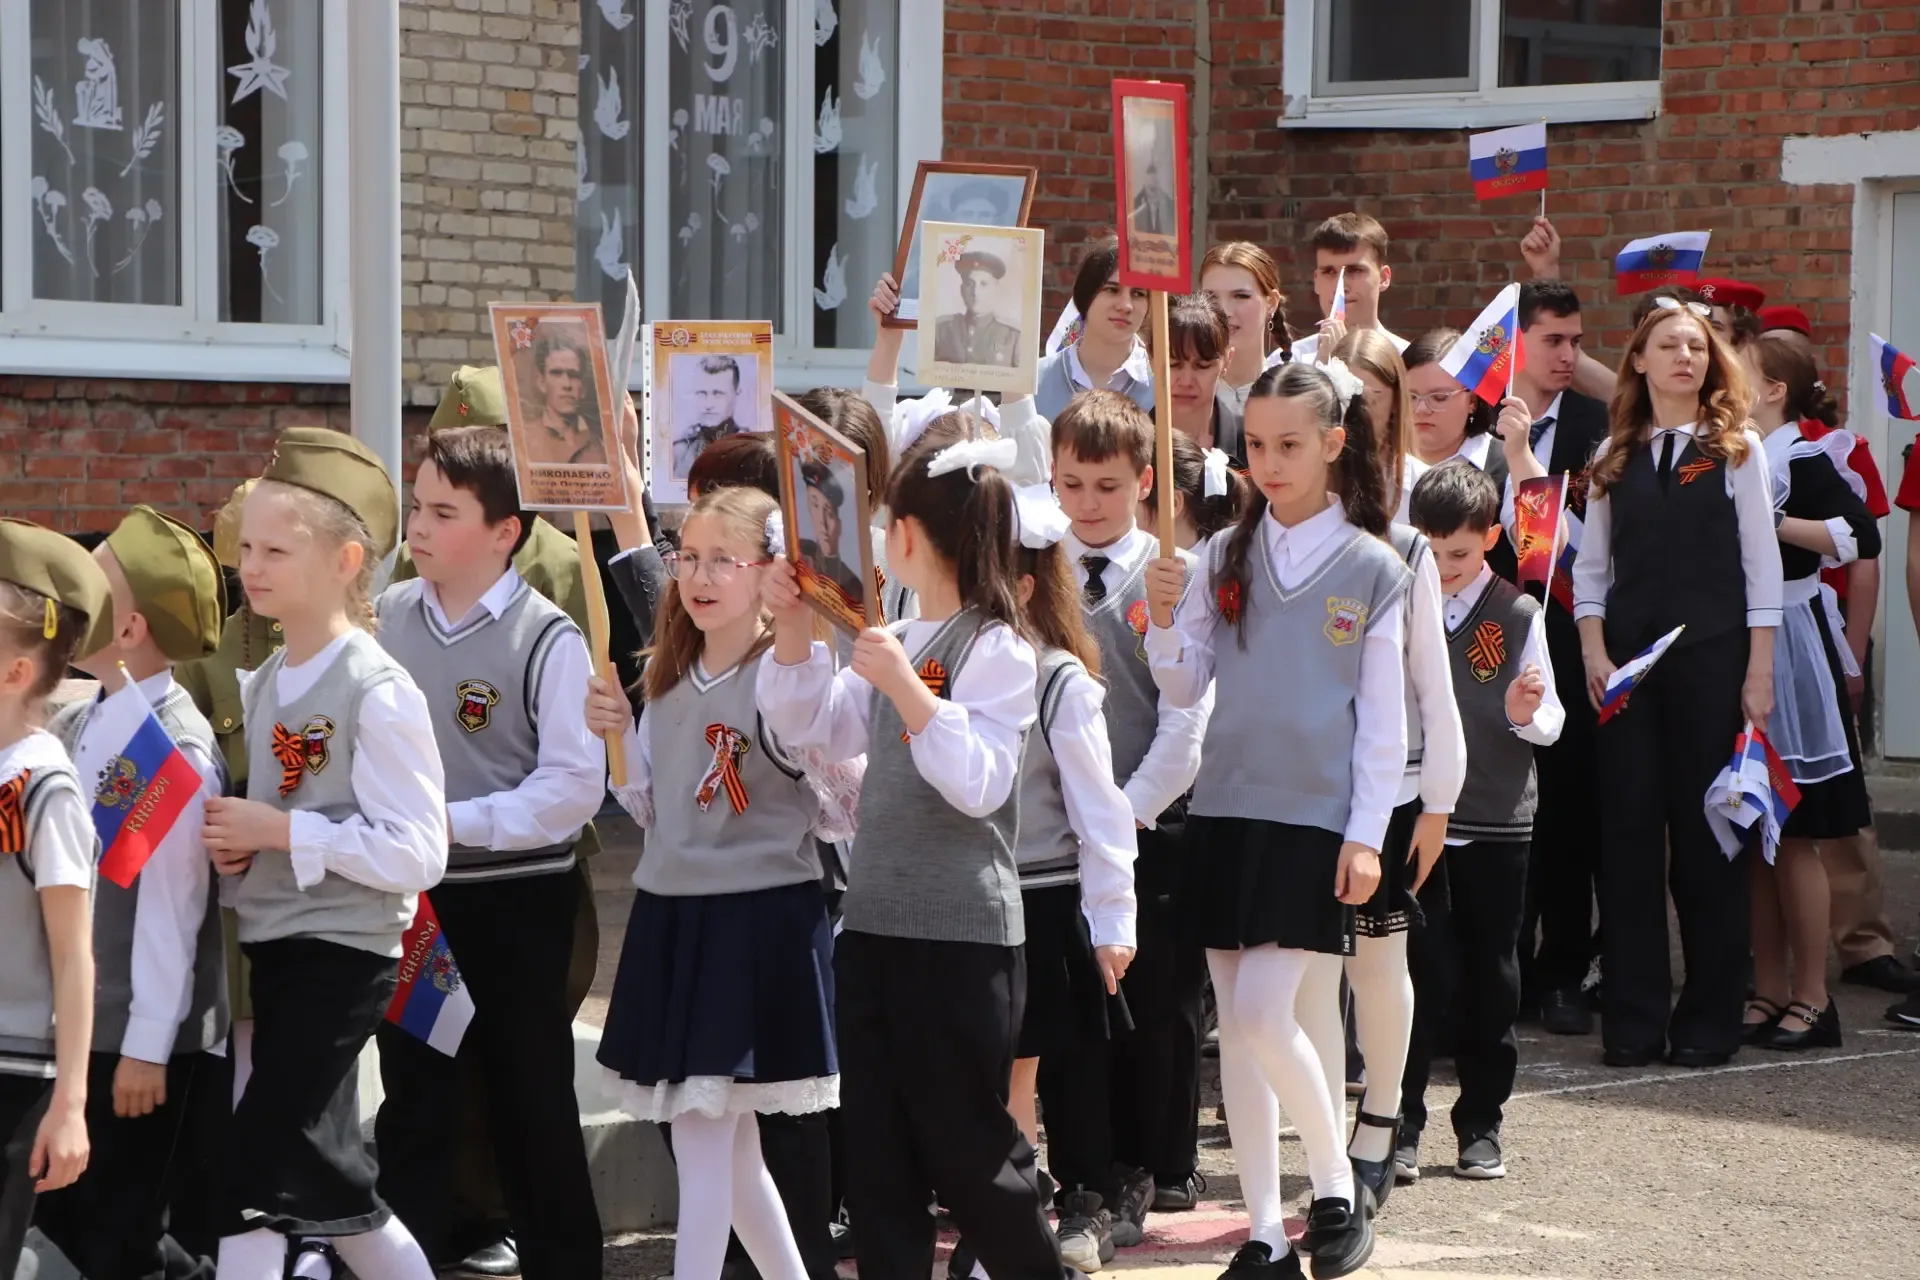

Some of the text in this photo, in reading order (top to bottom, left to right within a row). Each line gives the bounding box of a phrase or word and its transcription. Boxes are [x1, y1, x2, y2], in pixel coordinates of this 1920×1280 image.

[703, 4, 738, 82] 9
[694, 93, 743, 136] МАЯ
[530, 469, 612, 480] НИКОЛАЕНКО
[1333, 616, 1353, 633] 24
[464, 701, 484, 717] 24
[400, 919, 437, 984] РОССИЯ
